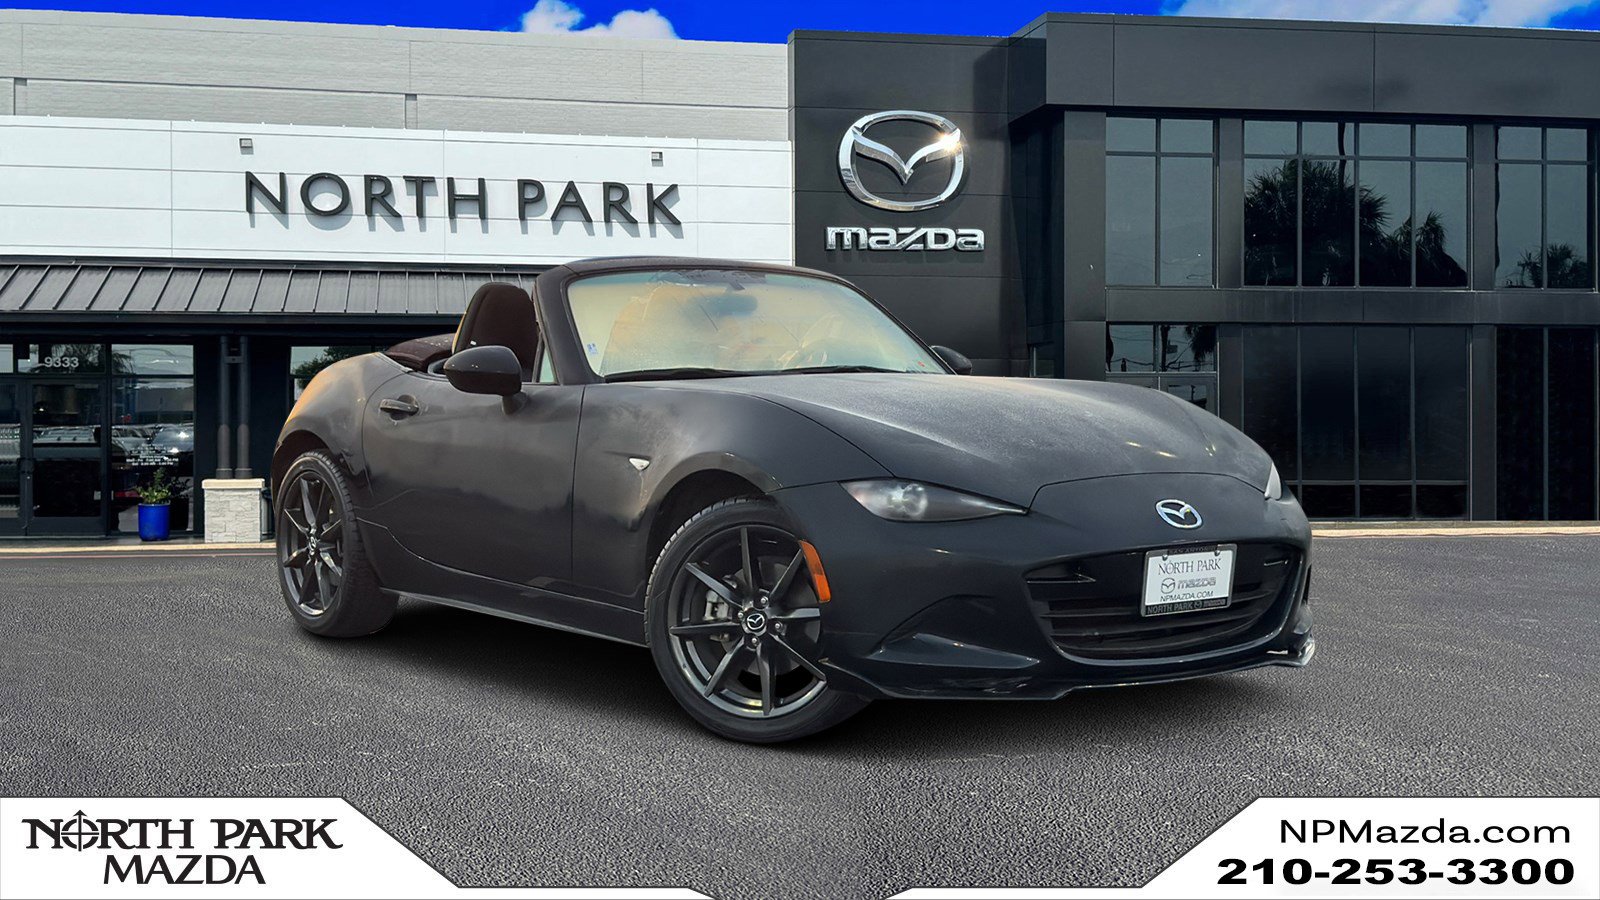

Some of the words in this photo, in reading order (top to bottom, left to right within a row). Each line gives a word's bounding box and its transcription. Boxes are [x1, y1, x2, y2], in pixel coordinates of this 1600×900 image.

[245, 171, 486, 220] NORTH
[517, 178, 682, 226] PARK
[44, 356, 79, 368] 9333
[1158, 560, 1194, 575] NORTH
[1197, 558, 1221, 572] PARK
[1160, 591, 1214, 602] NPMAZDA.COM
[1147, 604, 1172, 614] NORTH
[1174, 601, 1193, 611] PARK
